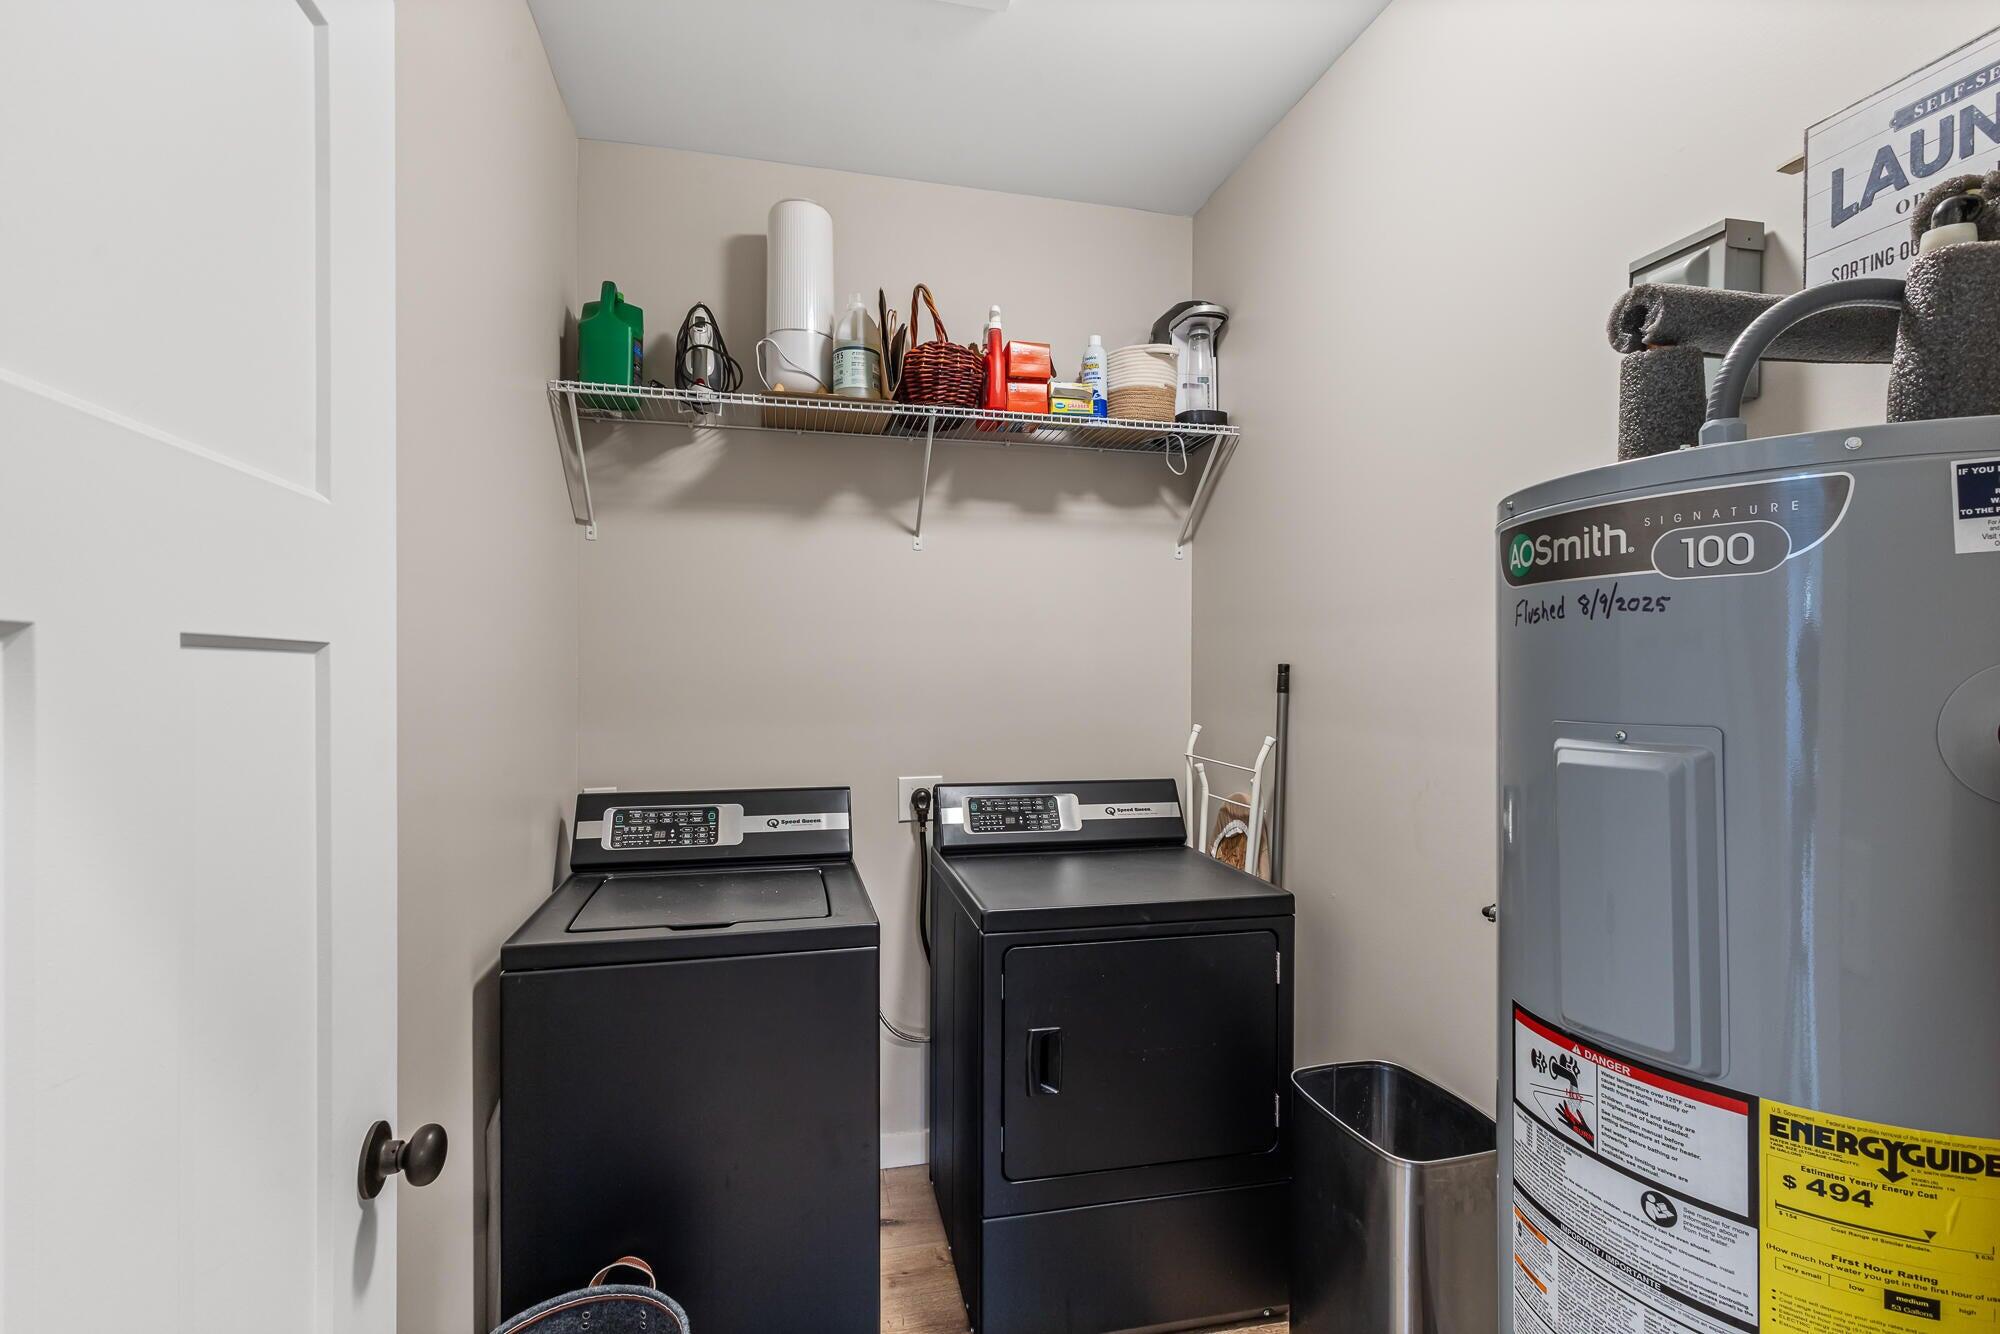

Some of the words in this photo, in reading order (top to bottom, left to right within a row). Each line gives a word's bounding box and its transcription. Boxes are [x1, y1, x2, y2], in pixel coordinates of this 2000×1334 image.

[1831, 91, 2000, 228] LAUN
[1831, 247, 1895, 283] SORTING
[1958, 468, 1968, 476] IF
[1971, 466, 1994, 474] YOU
[1644, 500, 1799, 527] SIGNATURE
[1975, 506, 1994, 514] THE
[1680, 532, 1755, 569] 100
[1515, 596, 1565, 627] Flushed
[1578, 582, 1671, 620] 8/9/2025
[1584, 1050, 1631, 1077] DANGER
[1601, 1070, 1615, 1080] Water
[1616, 1077, 1649, 1093] temperature
[1651, 1091, 1663, 1099] over
[1601, 1077, 1616, 1087] cause
[1617, 1085, 1635, 1095] severe
[1636, 1092, 1652, 1101] burns
[1654, 1099, 1680, 1112] instantly
[1601, 1083, 1615, 1093] death
[1616, 1090, 1629, 1099] from
[1630, 1096, 1649, 1107] scalds.
[1601, 1092, 1624, 1107] Children,
[1625, 1103, 1649, 1116] disabled
[1662, 1119, 1683, 1130] elderly
[1607, 1102, 1626, 1114] highest
[1627, 1110, 1637, 1119] risk
[1645, 1118, 1662, 1129] being
[1664, 1126, 1690, 1139] scalded.
[1783, 1110, 1815, 1122] Government
[1601, 1115, 1618, 1127] setting
[1619, 1124, 1652, 1141] temperature
[1661, 1142, 1678, 1151] water
[1679, 1148, 1701, 1160] heater.
[1601, 1131, 1629, 1148] showering.
[1601, 1124, 1612, 1133] Feel
[1613, 1131, 1627, 1140] water
[1628, 1137, 1646, 1149] before
[1647, 1145, 1670, 1159] bathing
[1611, 1113, 1640, 1129] instruction
[1641, 1127, 1663, 1139] manual
[1664, 1136, 1684, 1147] before
[1770, 1137, 1789, 1145] WATER
[1826, 1120, 1845, 1128] Federal
[1857, 1127, 1880, 1135] prohibits
[1601, 1140, 1633, 1159] Temperature
[1634, 1156, 1655, 1170] limiting
[1657, 1167, 1677, 1178] valves
[1770, 1141, 1785, 1149] TANK
[1770, 1114, 2000, 1182] ENERGYGUIDE
[1601, 1147, 1625, 1162] available,
[1637, 1164, 1660, 1177] manual.
[1782, 1174, 1797, 1190] $
[1806, 1179, 1874, 1208] 494
[1801, 1165, 1846, 1183] Estimated
[1849, 1172, 1879, 1191] Yearly
[1881, 1183, 1914, 1199] Energy
[1917, 1188, 1938, 1200] Cost
[1603, 1210, 1629, 1227] temperatures
[1631, 1225, 1640, 1233] may
[1641, 1231, 1654, 1239] occur
[1661, 1240, 1677, 1250] certain
[1683, 1207, 1695, 1216] See
[1697, 1213, 1720, 1225] manual
[1732, 1227, 1749, 1236] more
[1683, 1214, 1718, 1230] information
[1719, 1228, 1738, 1239] about
[1785, 1212, 1798, 1220] 154
[1641, 1220, 1657, 1230] elderly
[1690, 1242, 1711, 1254] shorter.
[1683, 1220, 1716, 1237] preventing
[1717, 1233, 1736, 1244] burns
[1683, 1225, 1697, 1234] from
[1699, 1231, 1709, 1240] hot
[1710, 1237, 1730, 1248] water.
[1830, 1226, 1846, 1235] Cost
[1848, 1229, 1870, 1240] Range
[1880, 1237, 1904, 1248] Similar
[1905, 1242, 1930, 1252] Models
[1560, 1223, 1600, 1255] IMPORTANT
[1605, 1255, 1661, 1291] IMPORTANTE
[1766, 1242, 1788, 1256] (How
[1791, 1250, 1816, 1263] much
[1818, 1257, 1834, 1269] hot
[1836, 1264, 1862, 1276] water
[1864, 1271, 1882, 1283] you
[1884, 1276, 1899, 1288] get
[1901, 1280, 1910, 1288] in
[1912, 1282, 1928, 1292] the
[1930, 1285, 1949, 1296] first
[1951, 1289, 1973, 1300] hour
[1975, 1293, 1985, 1301] of
[1831, 1253, 1859, 1268] First
[1863, 1261, 1894, 1276] Hour
[1897, 1269, 1939, 1286] Rating
[1782, 1264, 1799, 1275] very
[1801, 1269, 1822, 1280] small
[1849, 1283, 1865, 1293] low
[1896, 1295, 1929, 1308] medium
[1891, 1304, 1902, 1312] 53
[1904, 1306, 1934, 1319] Gallons
[1958, 1307, 1977, 1316] high
